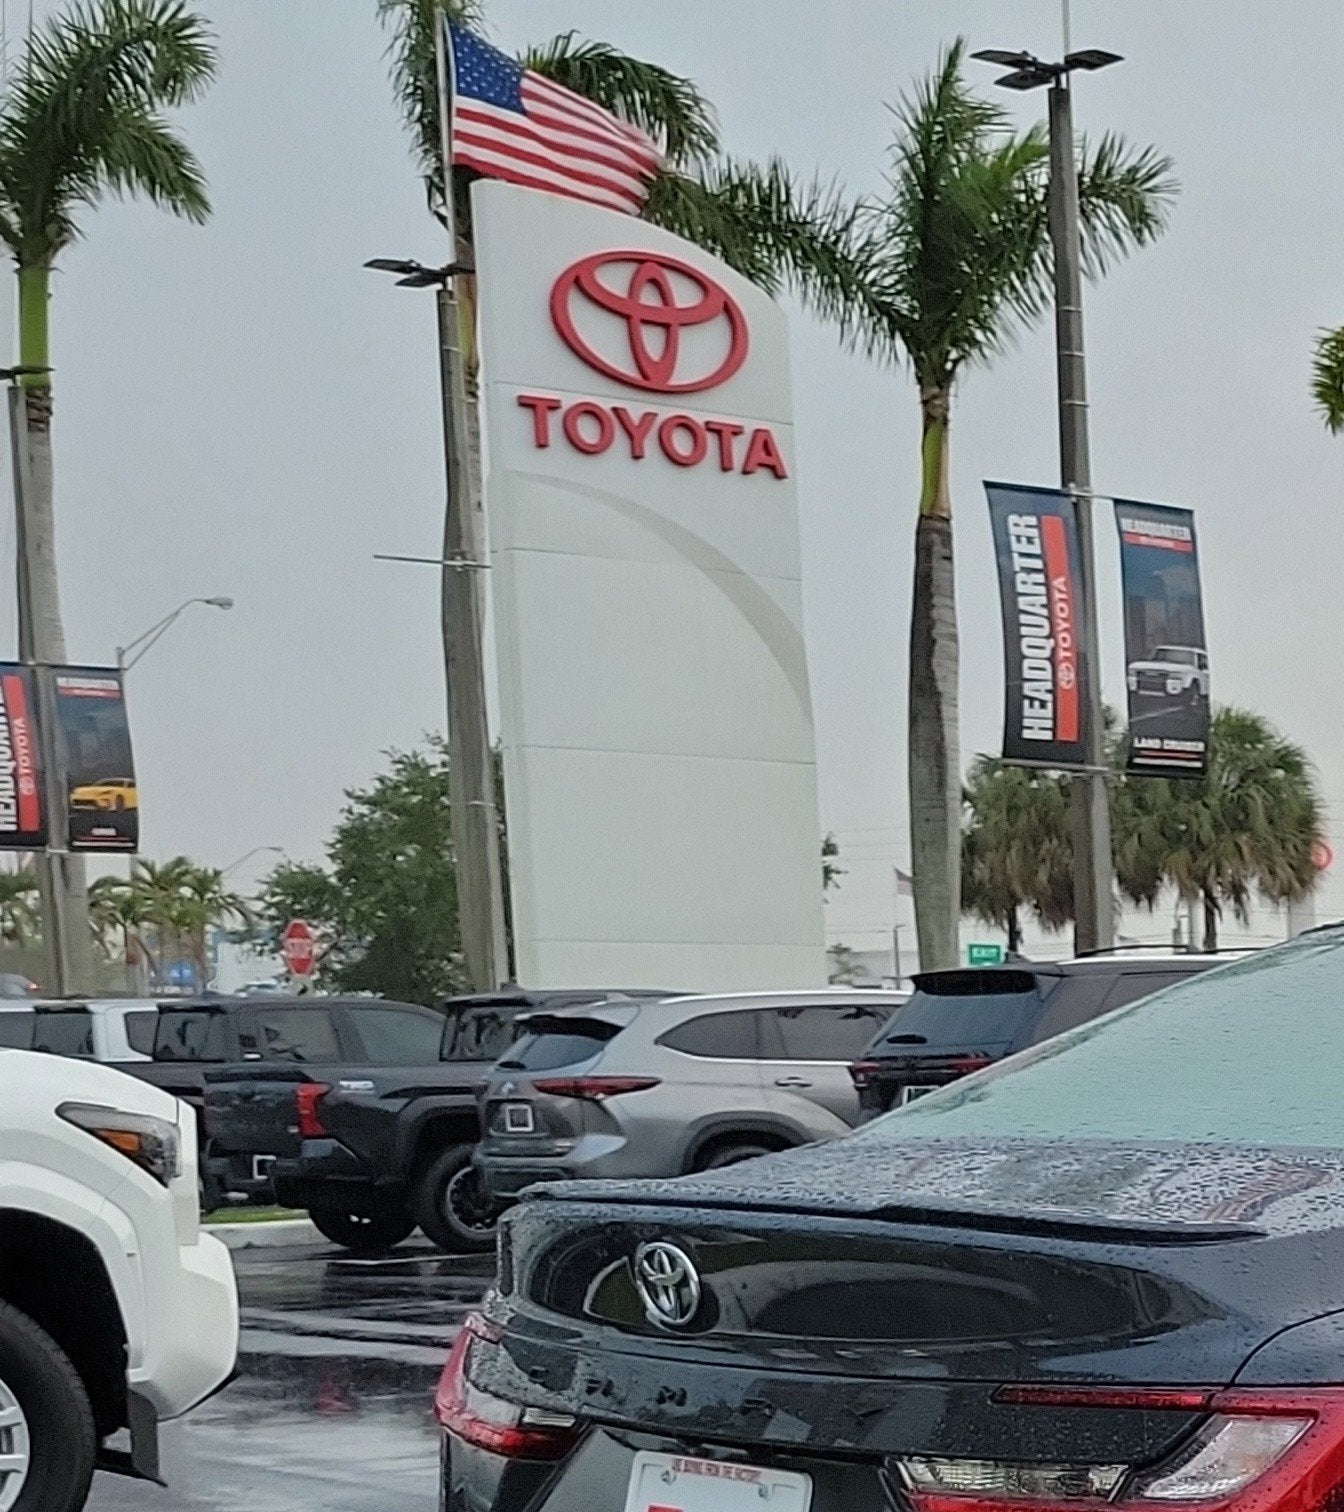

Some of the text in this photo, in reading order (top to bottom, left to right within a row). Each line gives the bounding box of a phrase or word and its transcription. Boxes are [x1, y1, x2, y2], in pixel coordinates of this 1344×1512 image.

[517, 395, 788, 480] TOYOTA
[1007, 513, 1055, 741] HEADQUARTER
[1051, 575, 1073, 664] TOYOTA
[13, 717, 31, 775] TOYOTA
